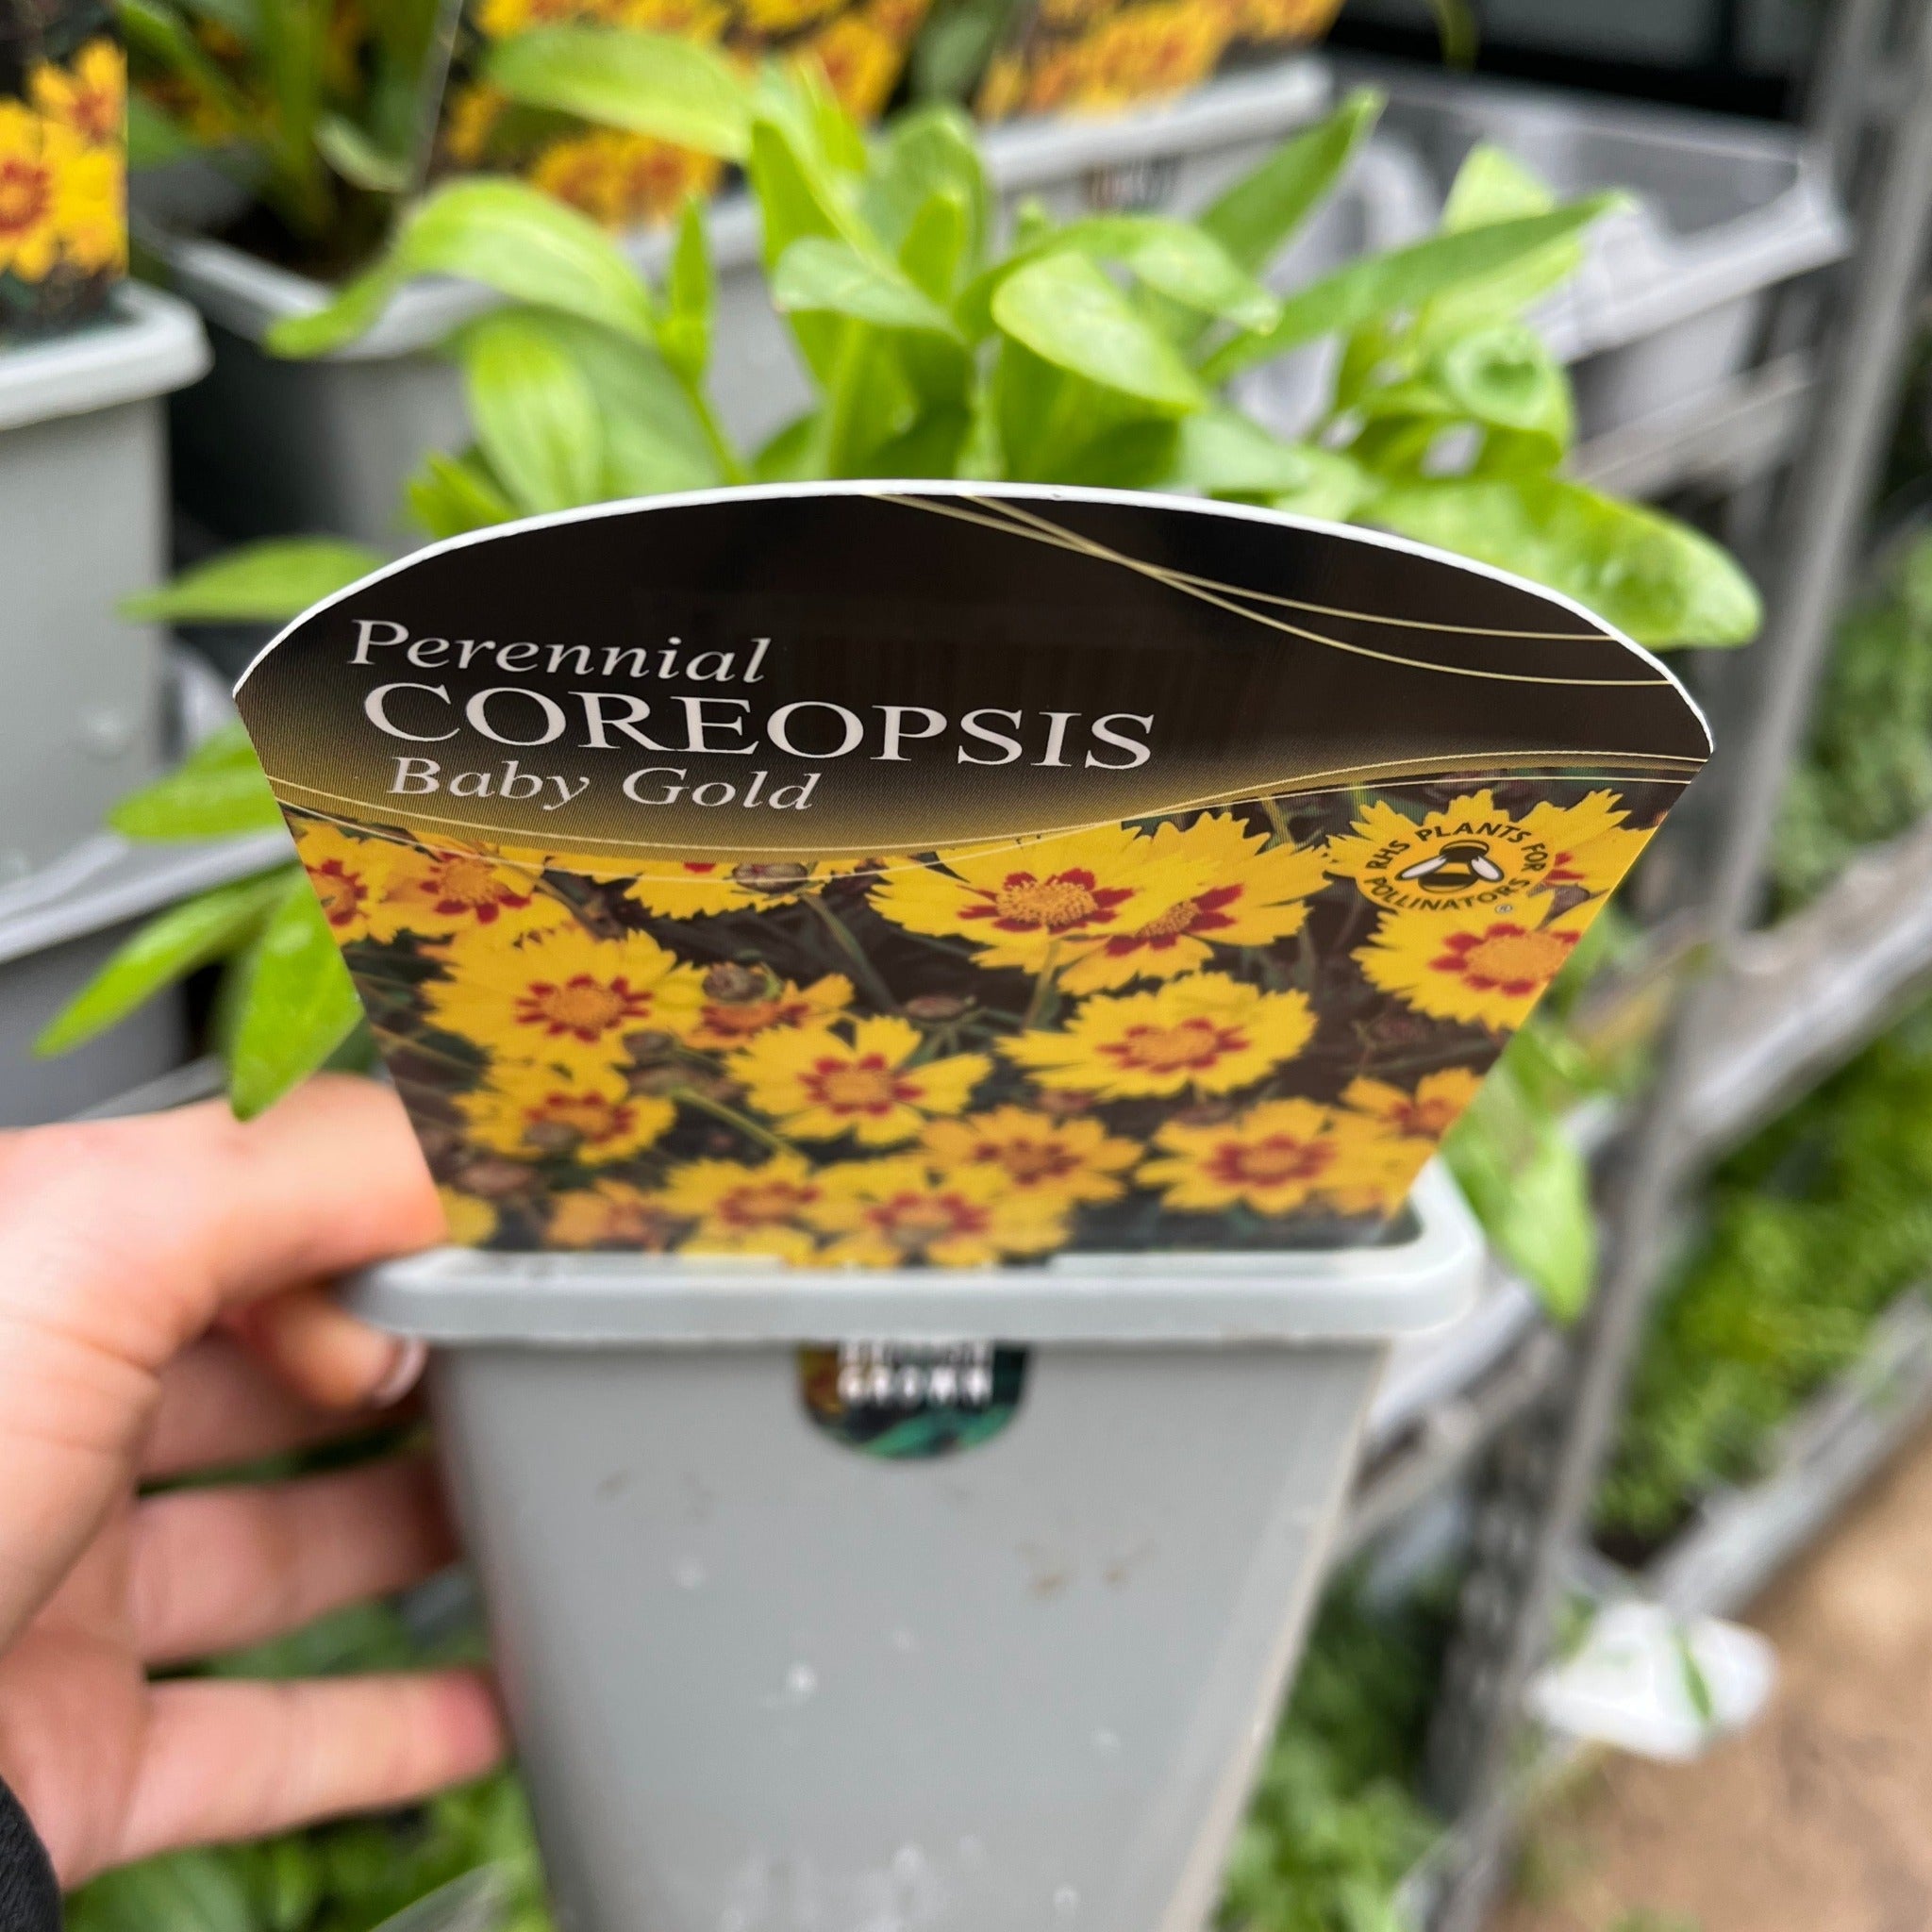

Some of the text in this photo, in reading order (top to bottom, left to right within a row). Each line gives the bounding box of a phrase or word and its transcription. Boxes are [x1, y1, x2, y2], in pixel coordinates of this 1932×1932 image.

[347, 619, 771, 683] Perennial
[364, 682, 1155, 770] COREOPSIS
[387, 757, 822, 810] Baby Gold
[1365, 822, 1549, 873] RHS PLANTS FOR
[1364, 876, 1530, 911] POLLINATORS
